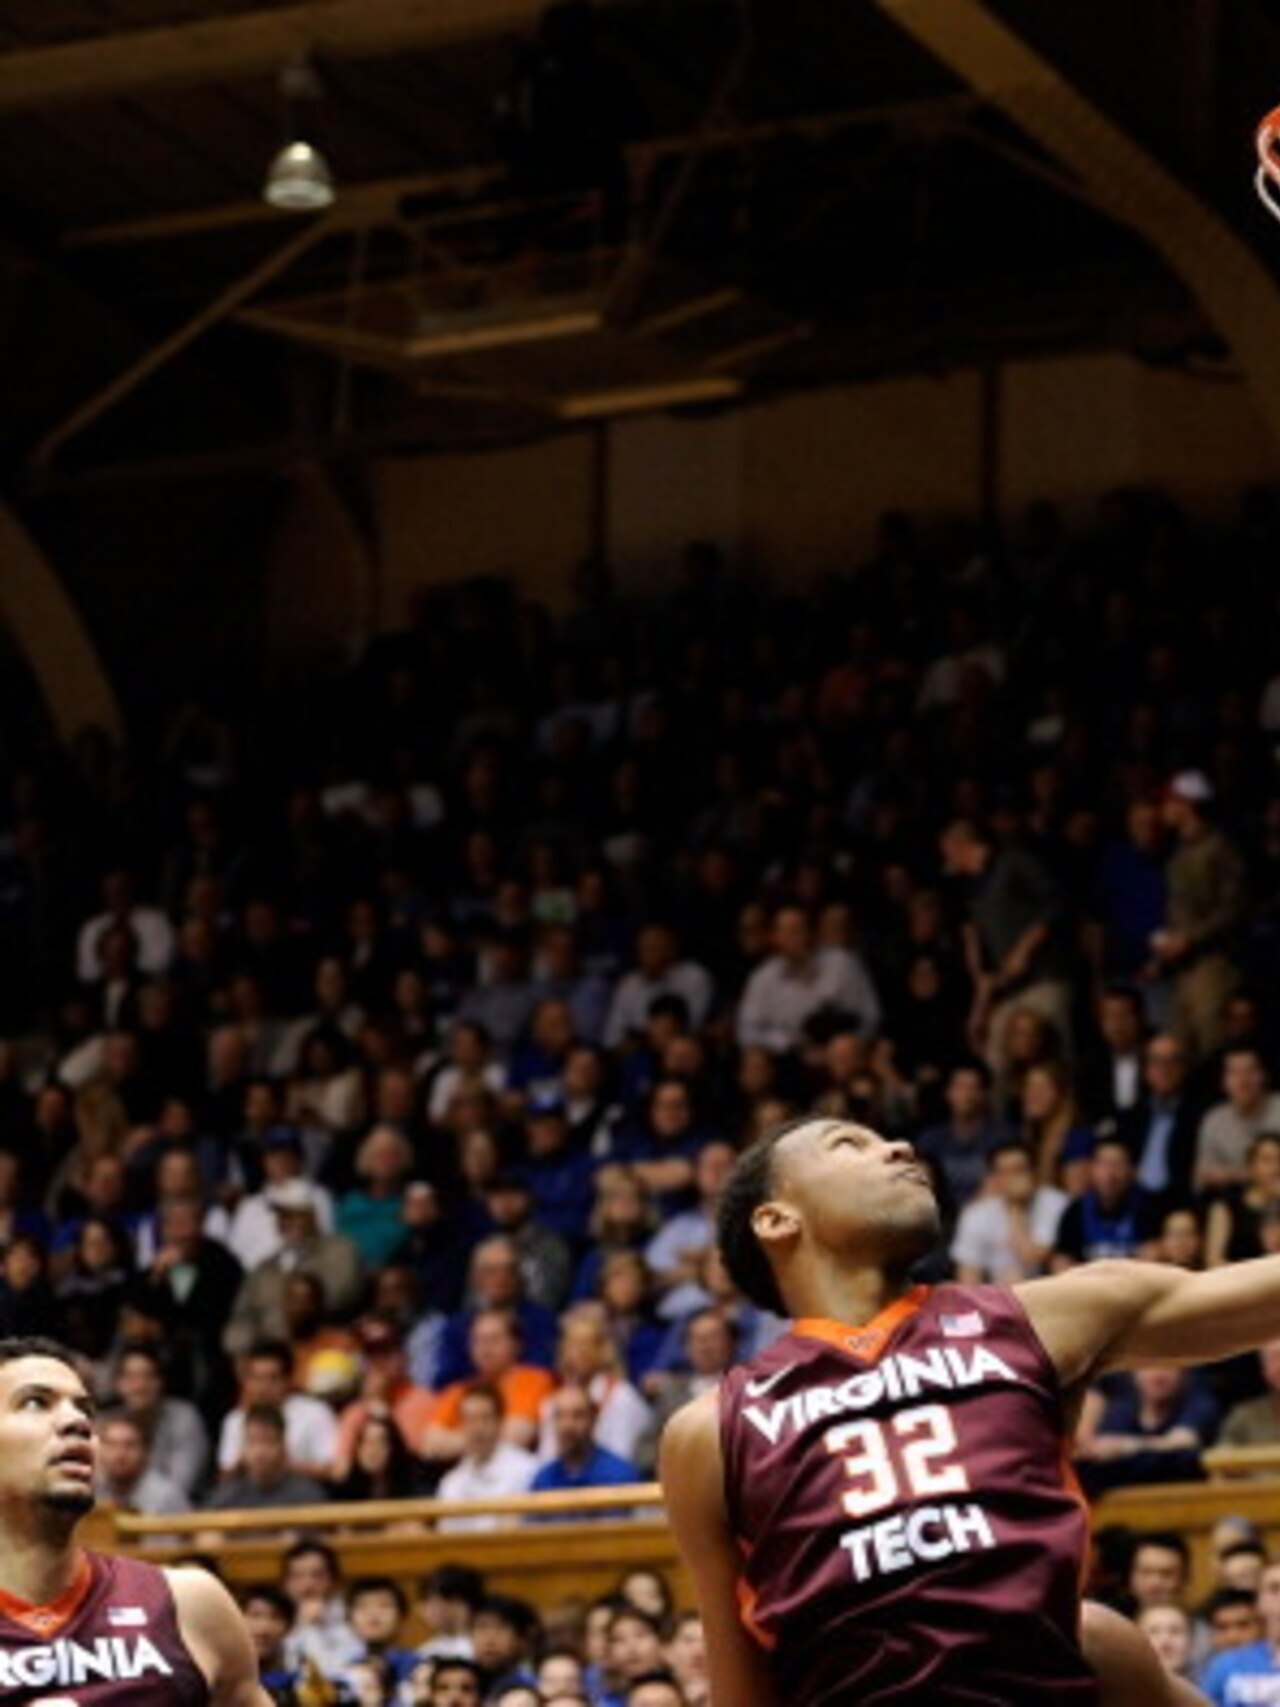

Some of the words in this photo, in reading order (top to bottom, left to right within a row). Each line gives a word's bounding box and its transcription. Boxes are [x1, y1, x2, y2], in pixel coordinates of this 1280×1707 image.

[742, 1345, 1018, 1444] VIRGINIA
[824, 1403, 970, 1518] 32
[840, 1503, 996, 1583] TECH
